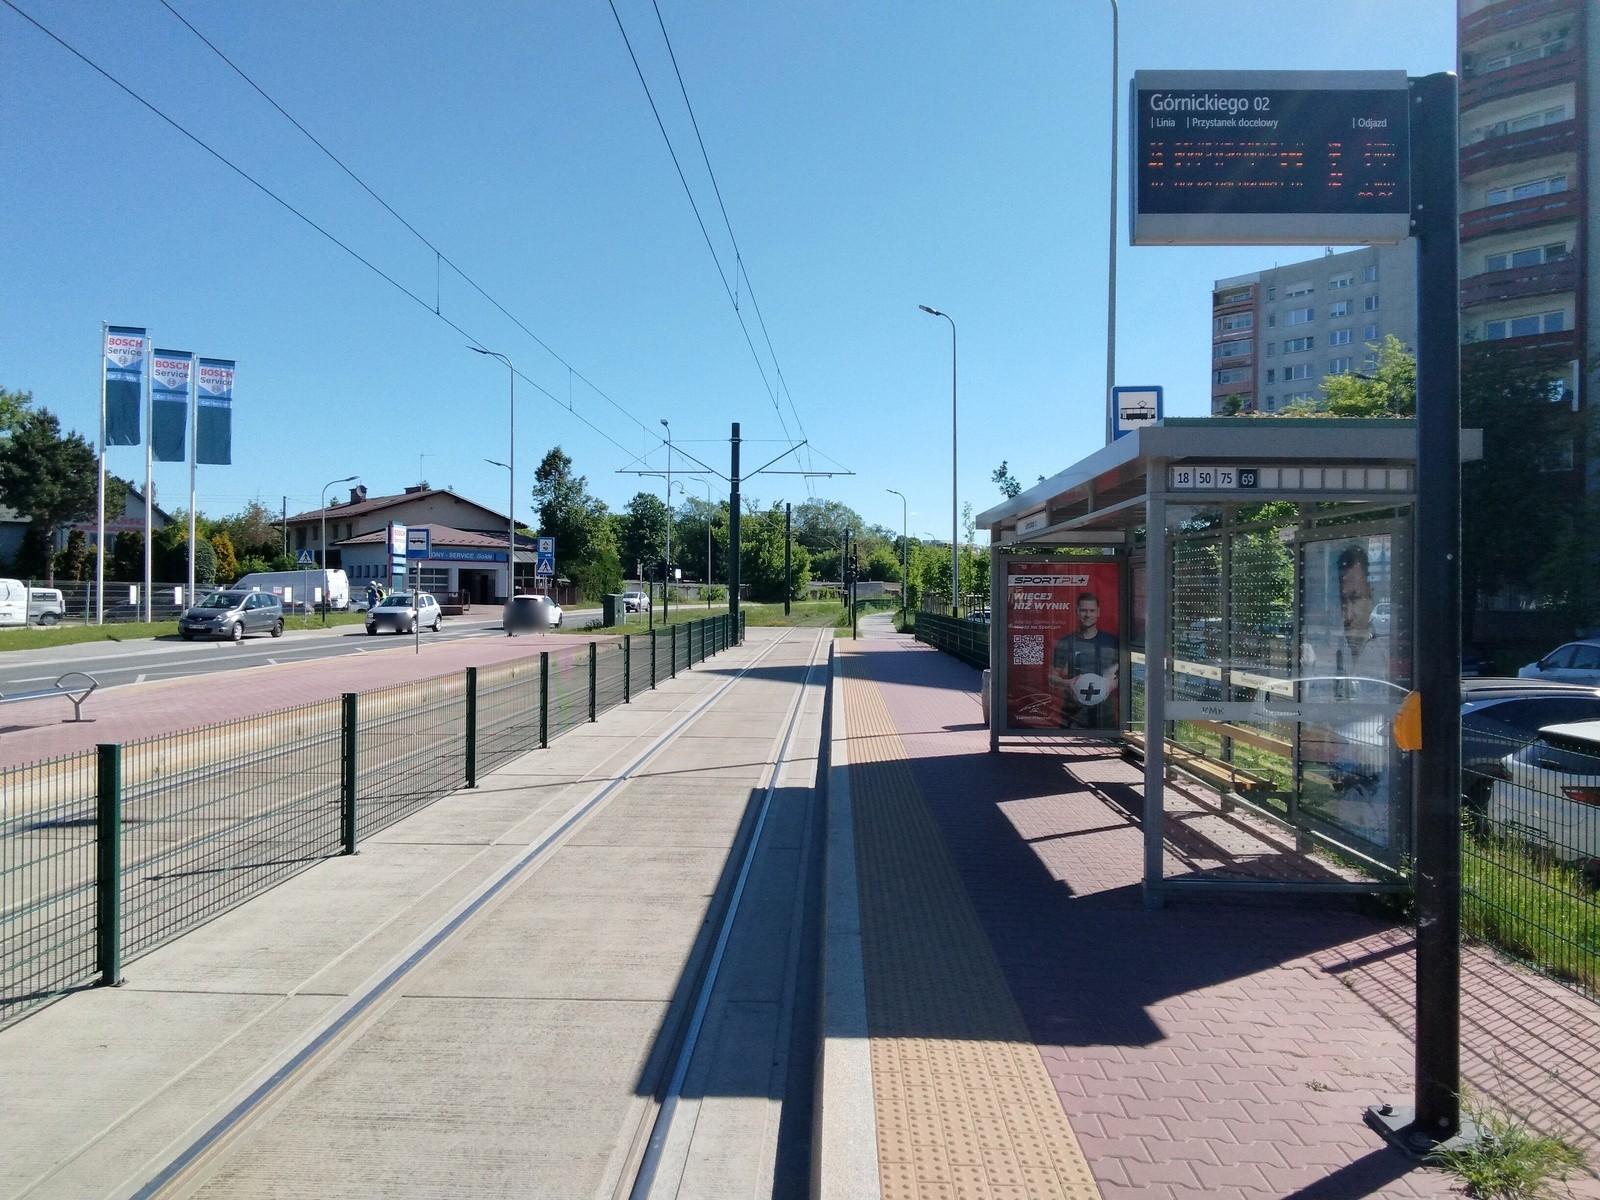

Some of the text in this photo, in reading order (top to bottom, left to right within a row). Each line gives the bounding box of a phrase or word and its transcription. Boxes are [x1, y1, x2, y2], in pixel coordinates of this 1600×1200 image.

[1150, 93, 1270, 115] Górnickiego 02
[1156, 118, 1176, 127] Linia
[1192, 117, 1279, 129] Przystanek docelowy
[1357, 118, 1387, 129] Odjazd
[108, 337, 143, 348] BOSCH
[107, 347, 142, 357] Service
[155, 360, 190, 370] BOSCH
[154, 369, 190, 379] Service
[200, 368, 233, 378] BOSCH
[199, 376, 232, 386] Service
[1177, 472, 1190, 484] 18
[1199, 472, 1212, 484] 50
[1220, 472, 1233, 484] 75
[1241, 473, 1255, 485] 69
[1034, 602, 1070, 610] WYNIK
